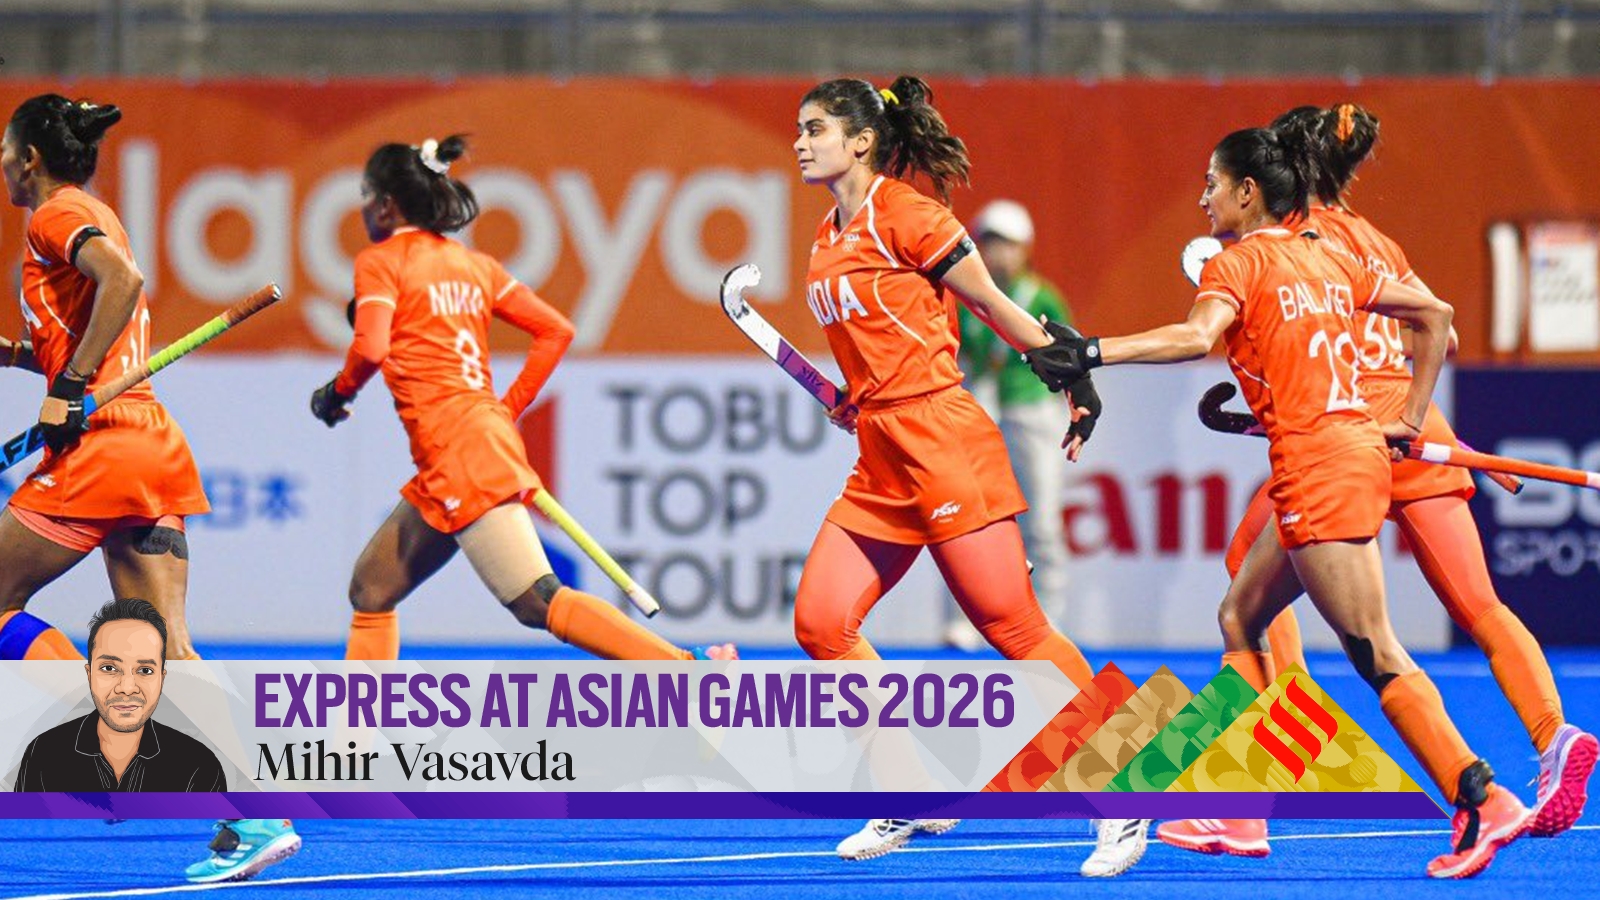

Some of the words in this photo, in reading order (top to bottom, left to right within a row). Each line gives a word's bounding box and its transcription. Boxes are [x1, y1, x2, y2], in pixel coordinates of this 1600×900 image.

[12, 140, 790, 352] agoya
[455, 328, 485, 390] 8
[604, 383, 826, 452] TOBU
[604, 468, 766, 535] TOP
[931, 500, 962, 520] JSW
